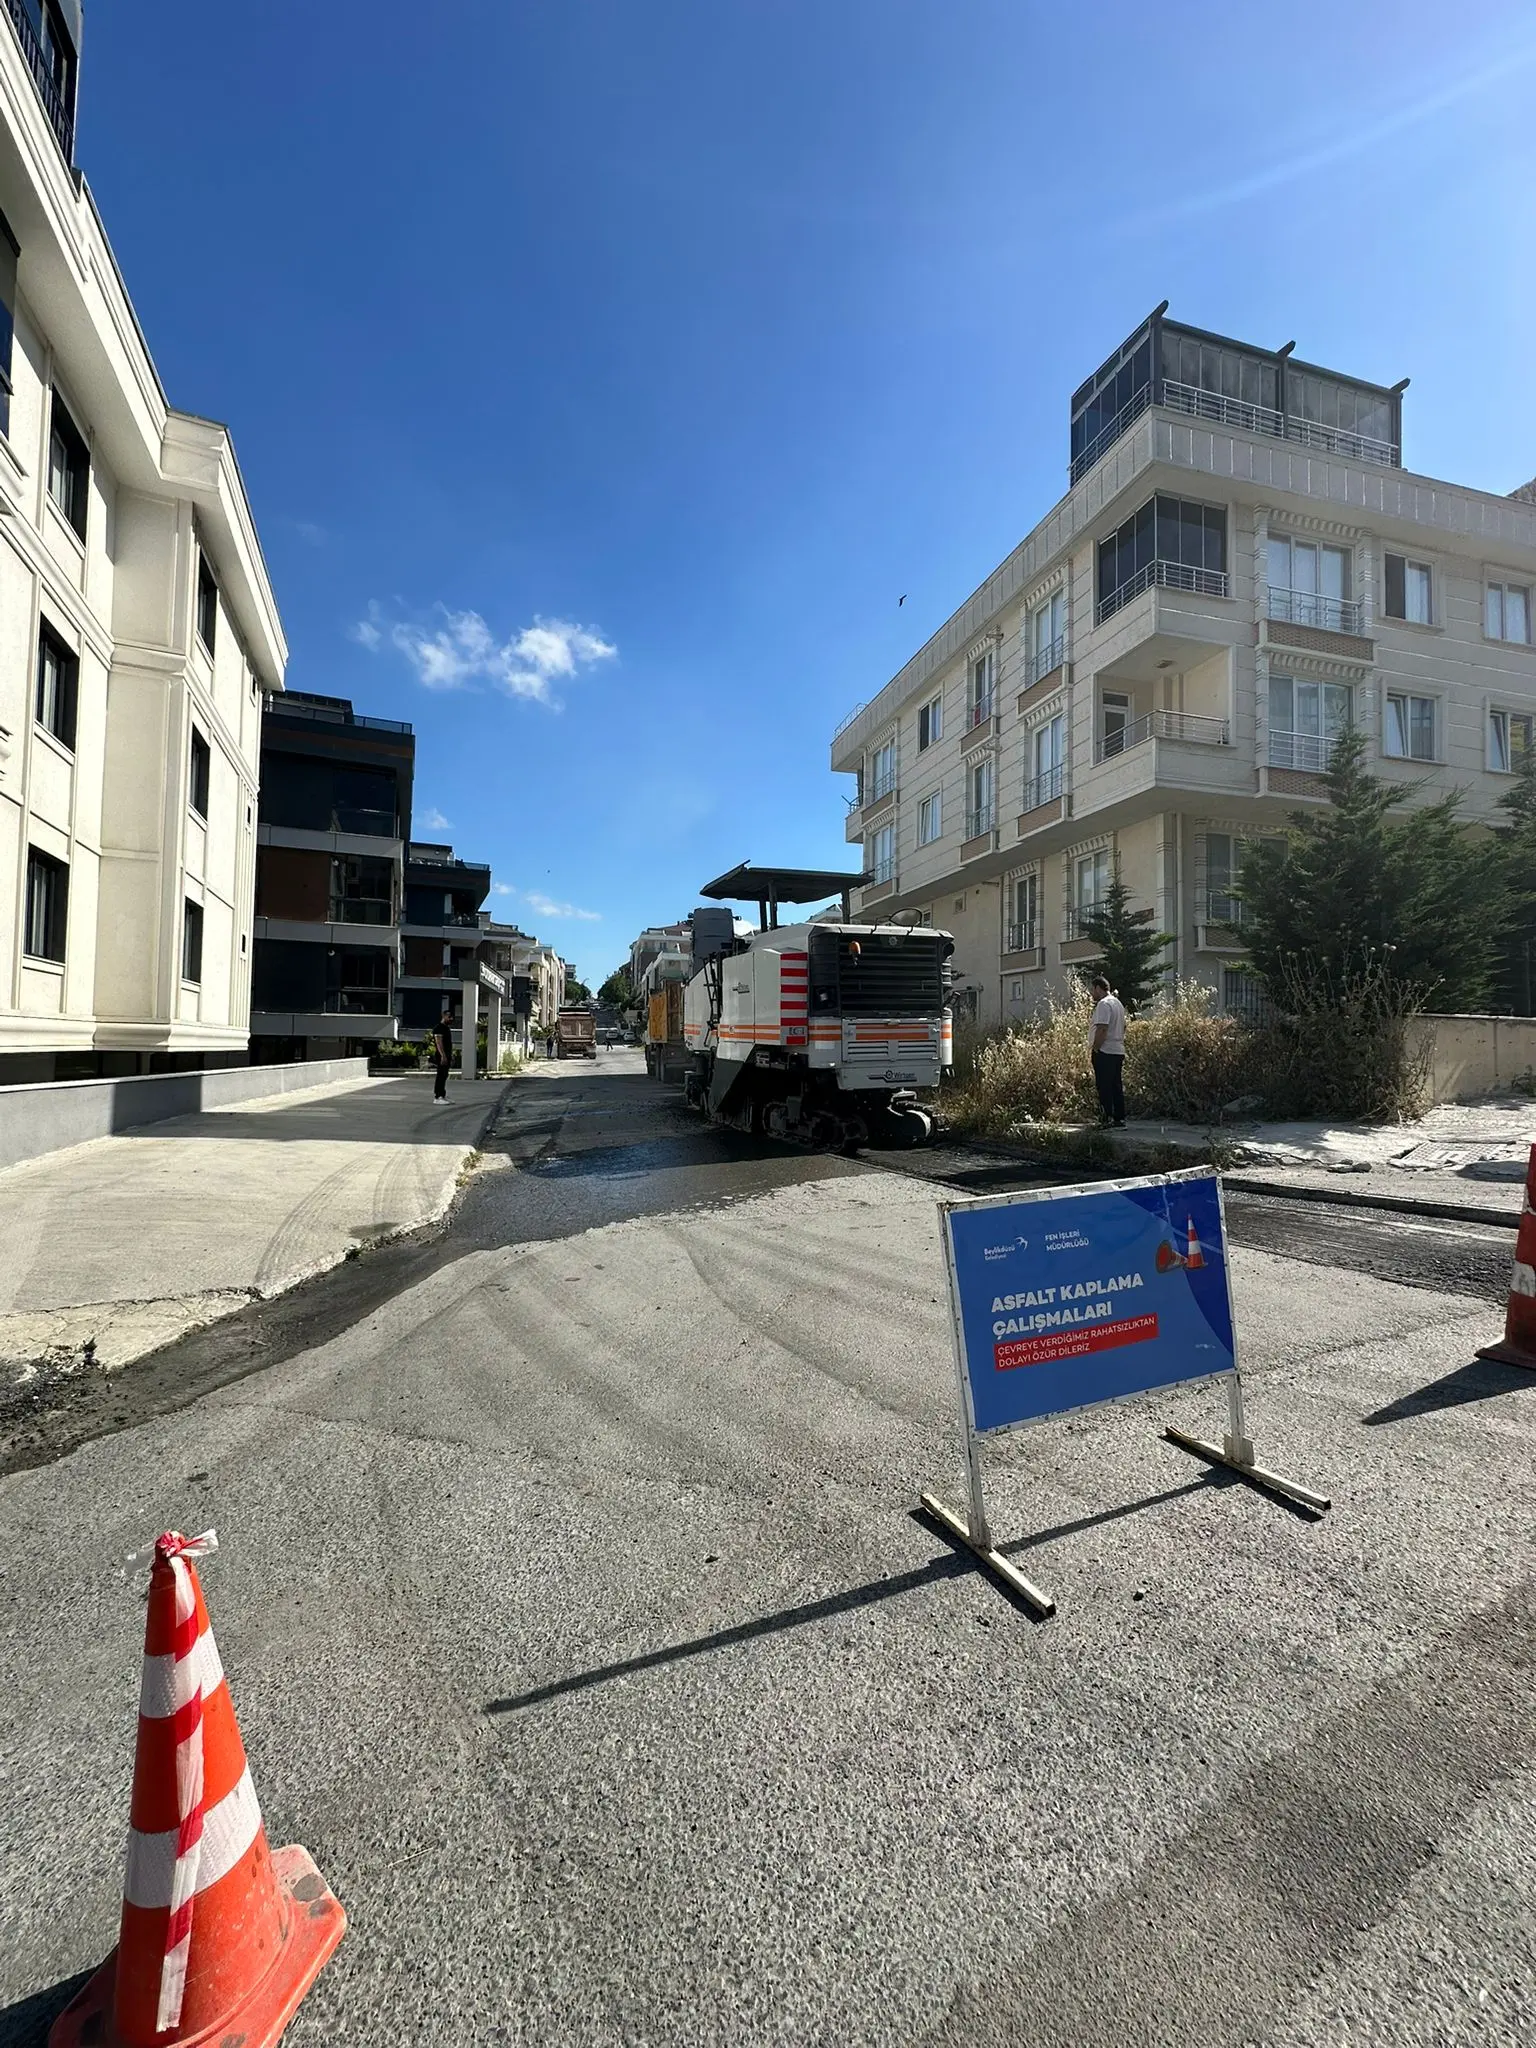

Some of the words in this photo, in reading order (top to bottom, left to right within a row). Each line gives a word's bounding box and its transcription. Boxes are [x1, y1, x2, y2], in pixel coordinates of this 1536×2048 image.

[1045, 1233, 1059, 1241] FEN
[1060, 1229, 1080, 1240] İŞLERİ
[1046, 1238, 1089, 1251] MÜDÜRLÜĞÜ
[991, 1287, 1056, 1313] ASFALT
[1060, 1272, 1144, 1301] KAPLAMA
[992, 1301, 1112, 1340] ÇALIŞMALARI
[998, 1341, 1039, 1356] ÇEVREYE
[1040, 1331, 1089, 1347] VERDİĞİMİZ
[1091, 1317, 1155, 1338] RAHATSIZLIKTAN
[999, 1354, 1031, 1368] DOLAYI
[1033, 1348, 1057, 1361] ÖZÜR
[1058, 1342, 1090, 1356] DİLERİZ
